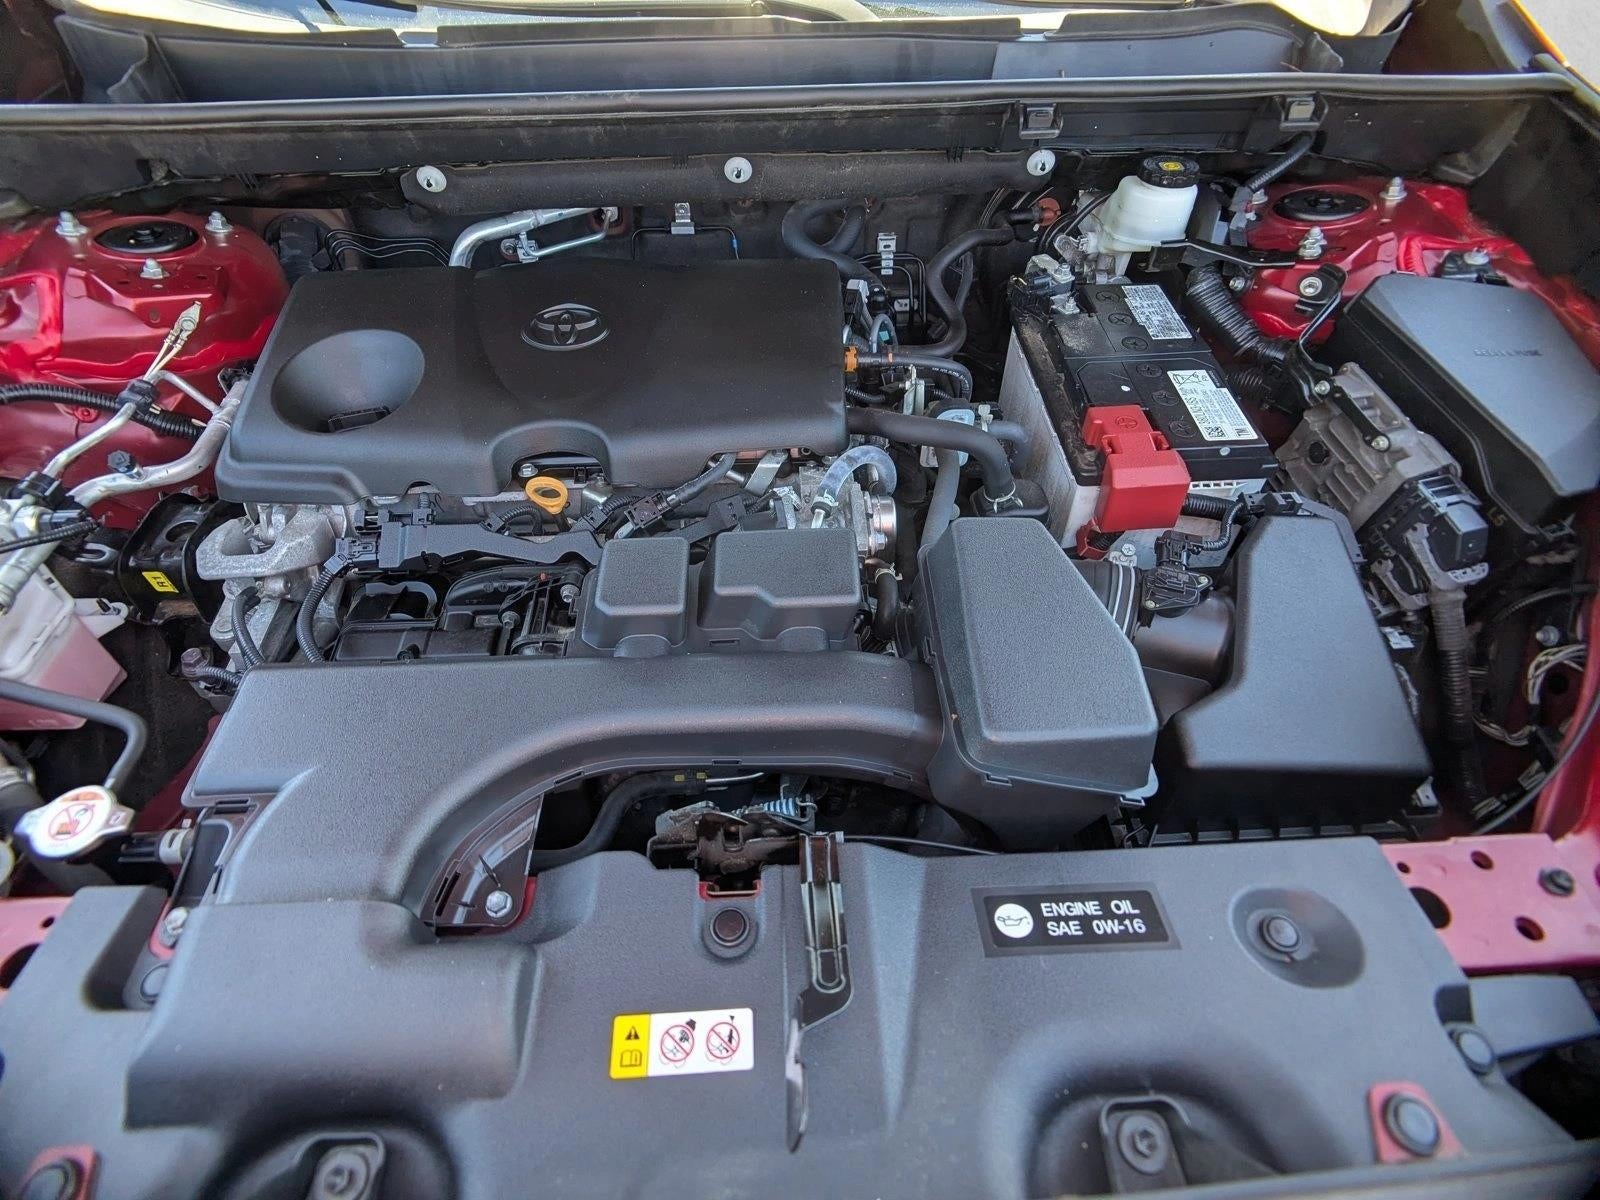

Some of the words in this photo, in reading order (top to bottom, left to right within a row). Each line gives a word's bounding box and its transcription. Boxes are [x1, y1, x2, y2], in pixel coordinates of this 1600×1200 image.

[1040, 901, 1103, 917] ENGINE
[1110, 899, 1141, 915] OIL
[1047, 920, 1083, 937] SAE
[1092, 918, 1147, 935] 0W-16
